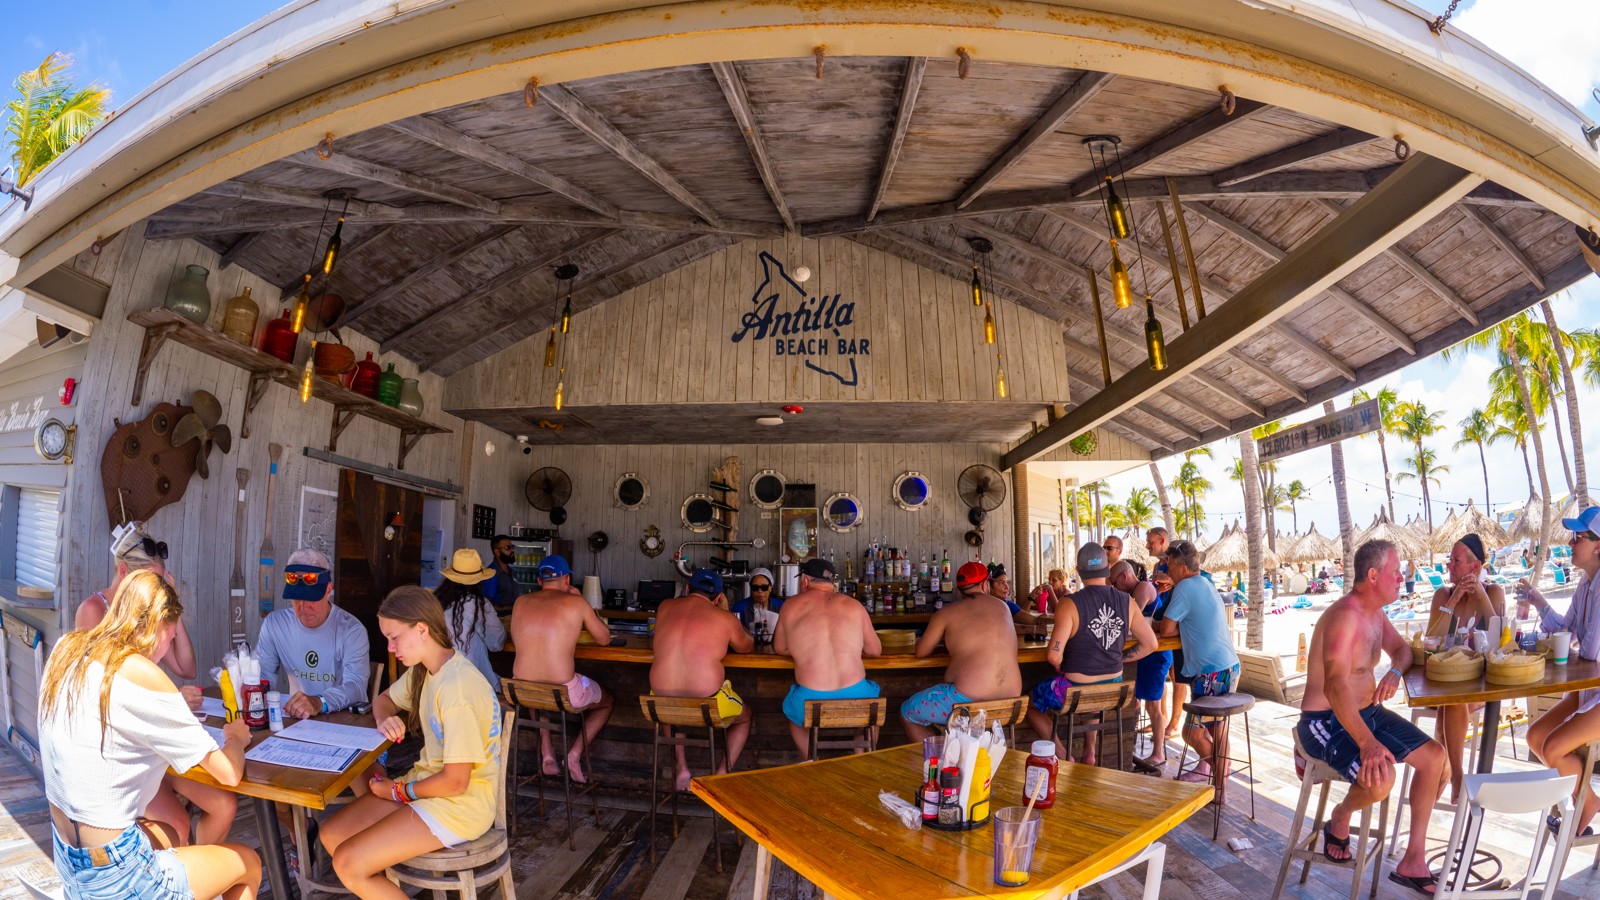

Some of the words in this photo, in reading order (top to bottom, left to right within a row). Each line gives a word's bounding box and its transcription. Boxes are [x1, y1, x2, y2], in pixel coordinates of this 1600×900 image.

[731, 293, 855, 343] Antilla
[776, 338, 828, 355] BEACH
[838, 338, 870, 355] BAR
[1301, 429, 1308, 446] N
[1360, 408, 1372, 426] W
[235, 606, 243, 623] 2
